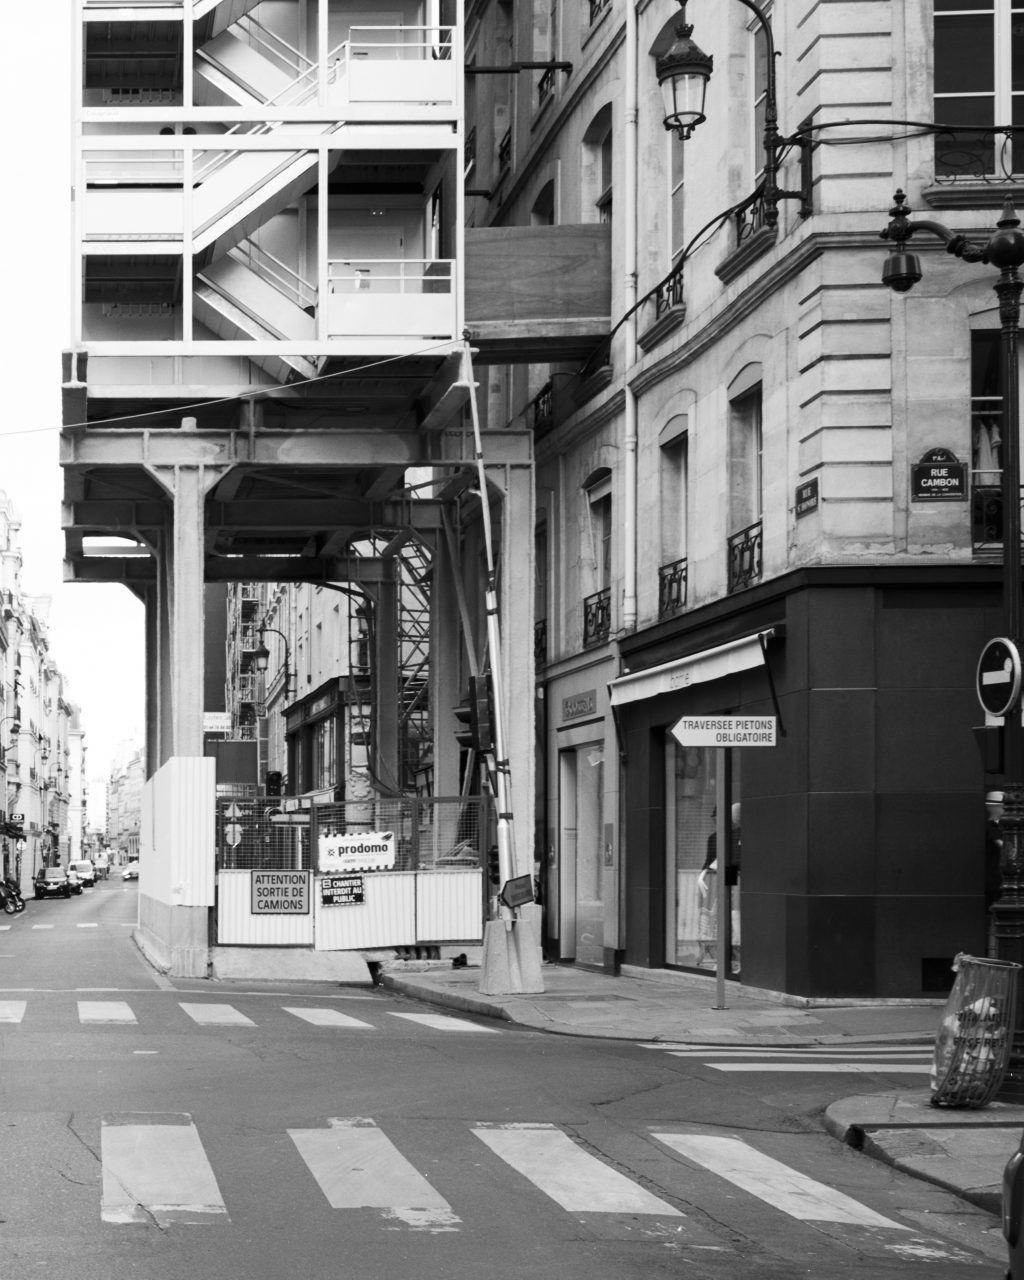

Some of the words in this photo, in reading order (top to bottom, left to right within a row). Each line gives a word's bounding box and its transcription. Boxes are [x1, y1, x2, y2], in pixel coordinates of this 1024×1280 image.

[930, 468, 949, 477] RUE
[921, 478, 959, 487] CAMBON
[683, 720, 733, 730] TRAVERSEE
[736, 720, 773, 730] PIETONS
[716, 732, 773, 742] OBLIGATOIRE
[338, 843, 388, 857] prodomo
[255, 874, 306, 885] ATTENTION
[332, 879, 362, 888] CHANTIER
[257, 887, 289, 898] SORTIE
[292, 887, 304, 897] DE
[322, 887, 352, 896] INTERDIT
[352, 886, 362, 894] AU
[333, 894, 356, 903] PUBLIC
[257, 899, 303, 910] CAMIONS
